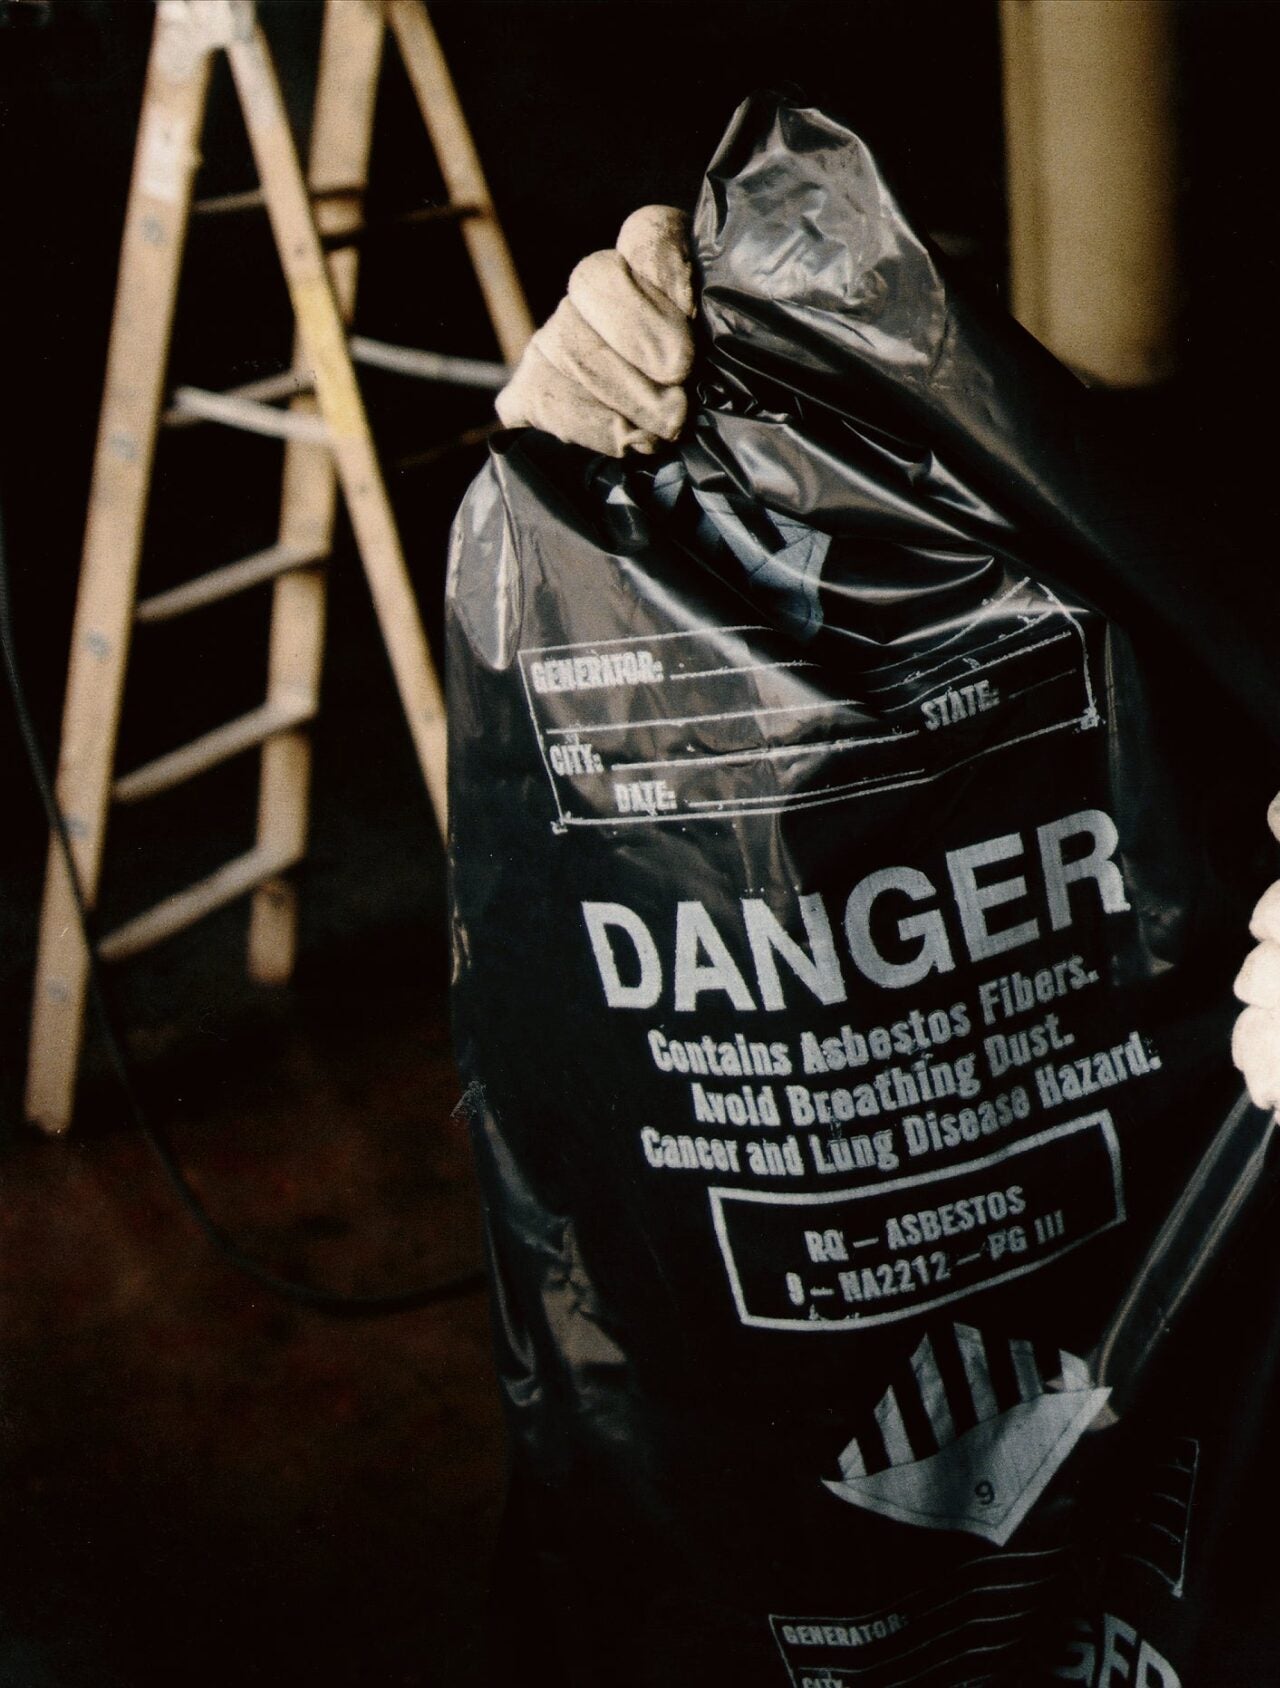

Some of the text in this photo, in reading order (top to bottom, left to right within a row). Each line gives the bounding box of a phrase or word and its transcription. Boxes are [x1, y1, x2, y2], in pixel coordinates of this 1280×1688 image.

[531, 651, 664, 693] GENERATOR:
[920, 681, 1000, 731] STATE:
[550, 743, 604, 776] CITY:
[614, 779, 678, 813] DATE:
[581, 809, 1130, 1012] DANGER
[648, 955, 1100, 1077] Contains Asbestos Fibers.
[691, 1012, 1075, 1127] Avoid Breathing Dust.
[640, 1030, 1162, 1176] Cancer and Lung Disease Hazard.
[886, 1185, 1026, 1250] ASBESTOS
[975, 1480, 995, 1506] 9
[781, 1613, 909, 1647] GENERATOR:
